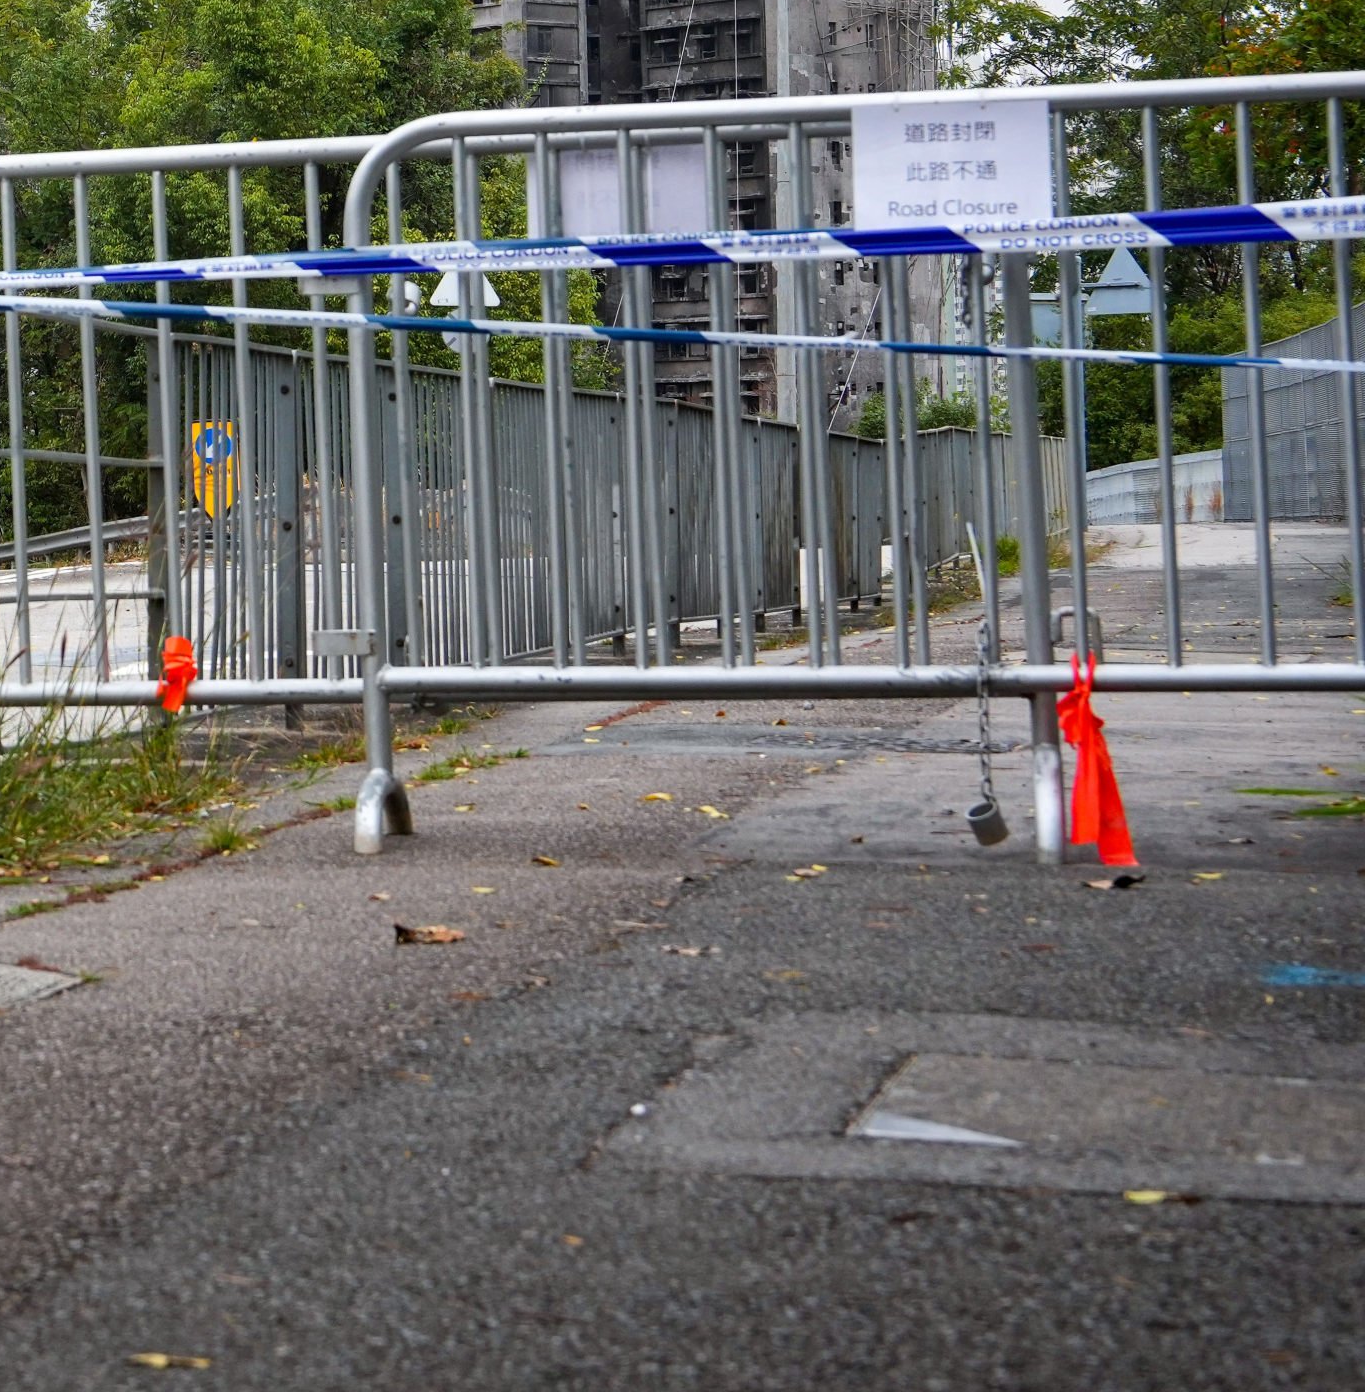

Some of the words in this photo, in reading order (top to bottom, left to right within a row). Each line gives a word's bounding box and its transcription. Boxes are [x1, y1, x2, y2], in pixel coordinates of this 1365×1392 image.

[903, 120, 996, 143] 道路封閉
[906, 160, 997, 182] 此路不通
[887, 200, 937, 217] Road
[942, 198, 1018, 216] Closure
[963, 219, 1033, 235] POLICE
[1001, 238, 1028, 250] DO
[1034, 235, 1073, 248] NOT
[1081, 230, 1150, 246] CROSS
